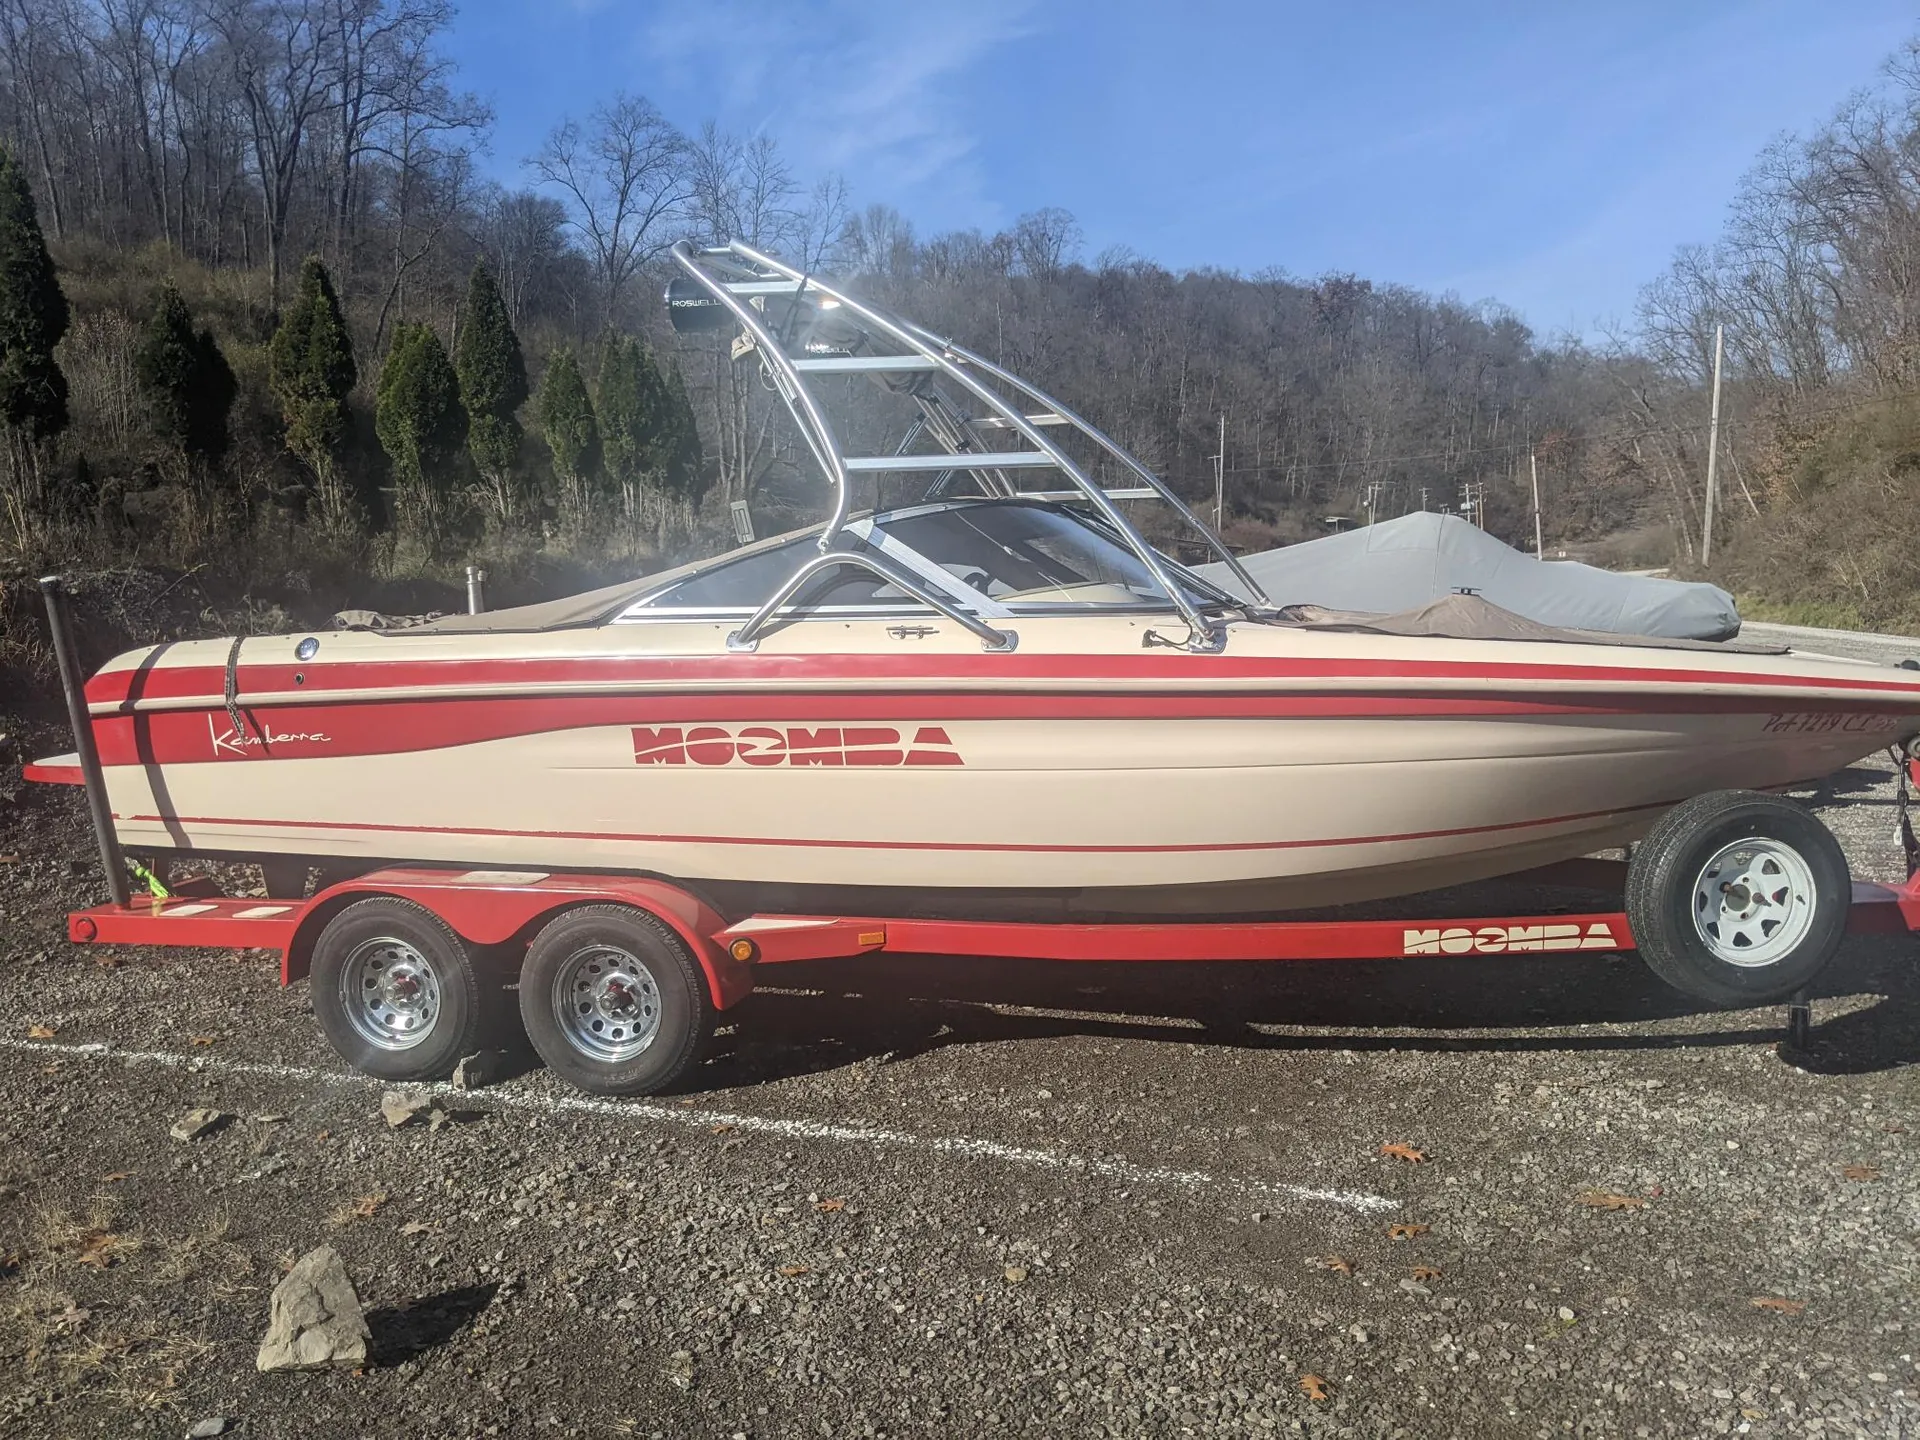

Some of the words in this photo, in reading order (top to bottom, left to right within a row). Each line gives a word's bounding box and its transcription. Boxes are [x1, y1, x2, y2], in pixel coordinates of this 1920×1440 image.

[671, 298, 722, 308] ROSWELL
[630, 726, 966, 767] MOOMBA
[1403, 923, 1618, 955] MOOMBA
